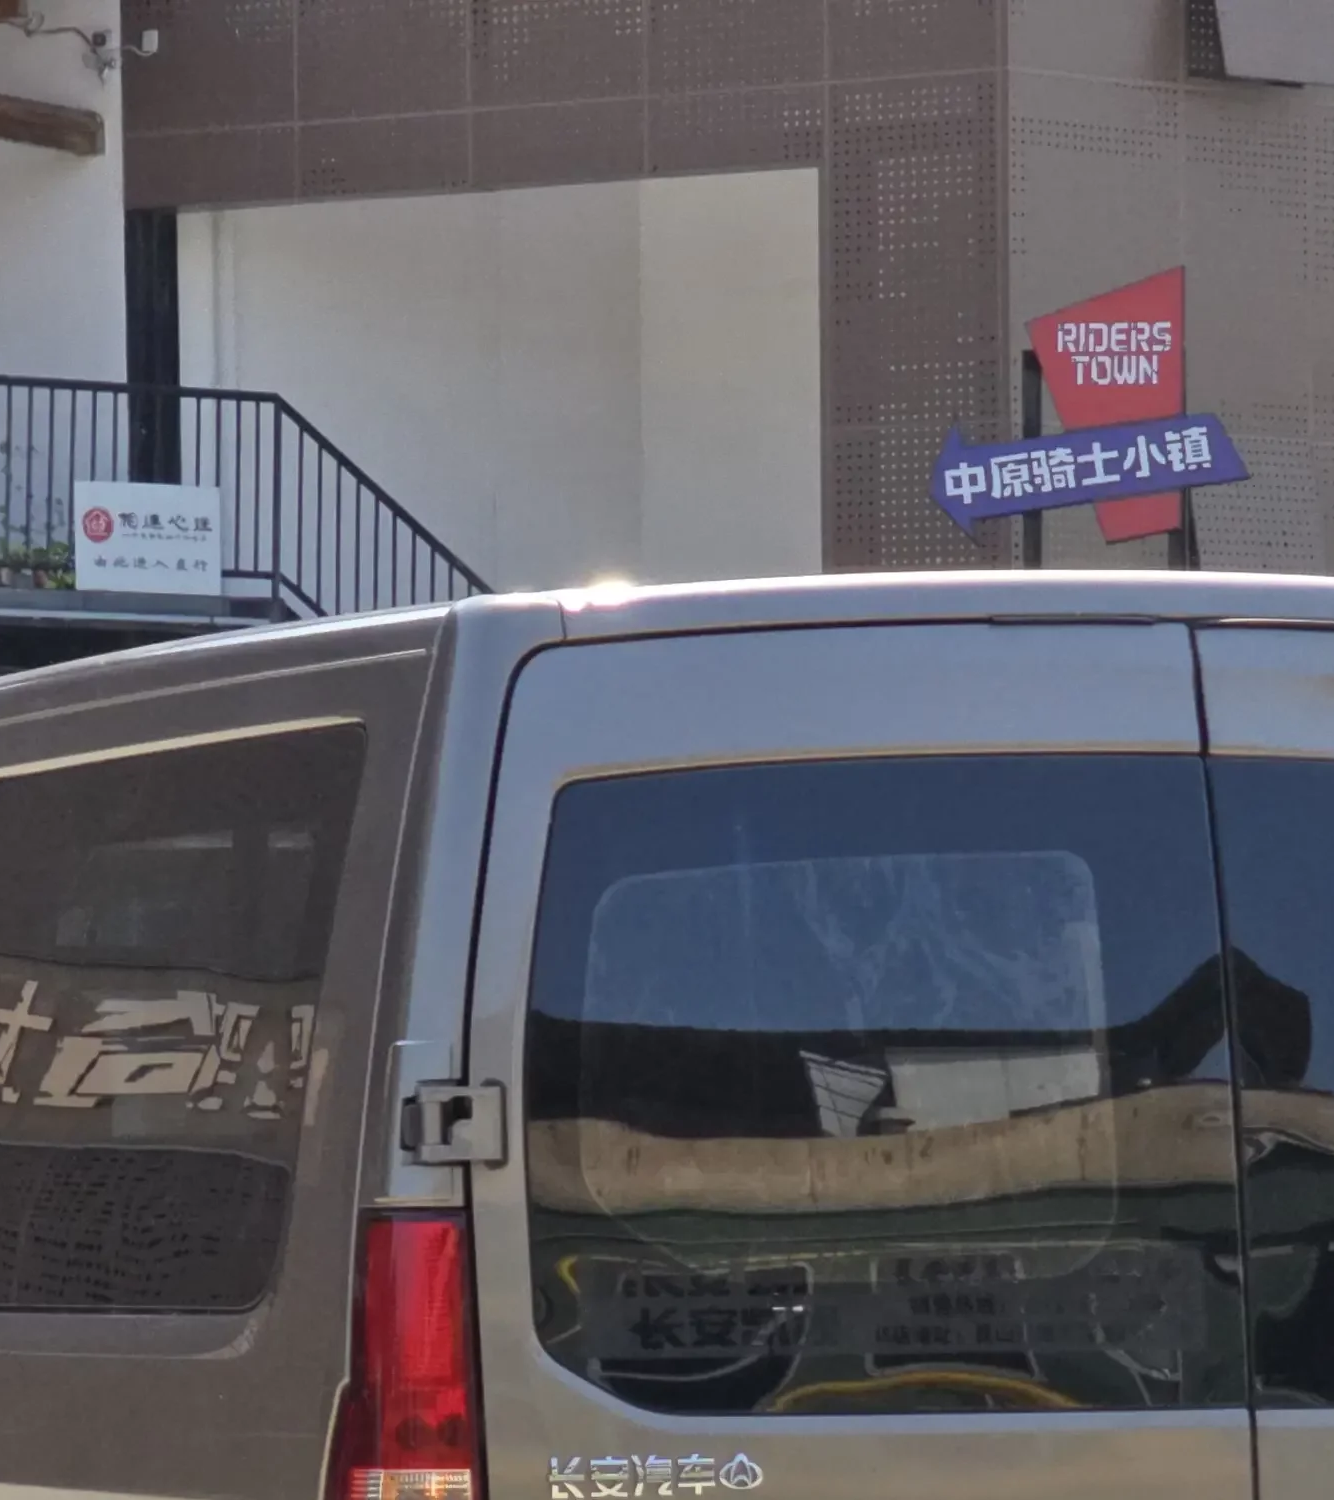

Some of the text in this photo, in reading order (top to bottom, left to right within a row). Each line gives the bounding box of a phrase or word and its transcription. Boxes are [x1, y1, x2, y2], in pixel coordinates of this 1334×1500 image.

[1056, 321, 1173, 354] RIDERS
[1071, 354, 1160, 386] TOWN
[944, 426, 1213, 506] 中原骑士小镇
[549, 1453, 716, 1499] 长安汽车
